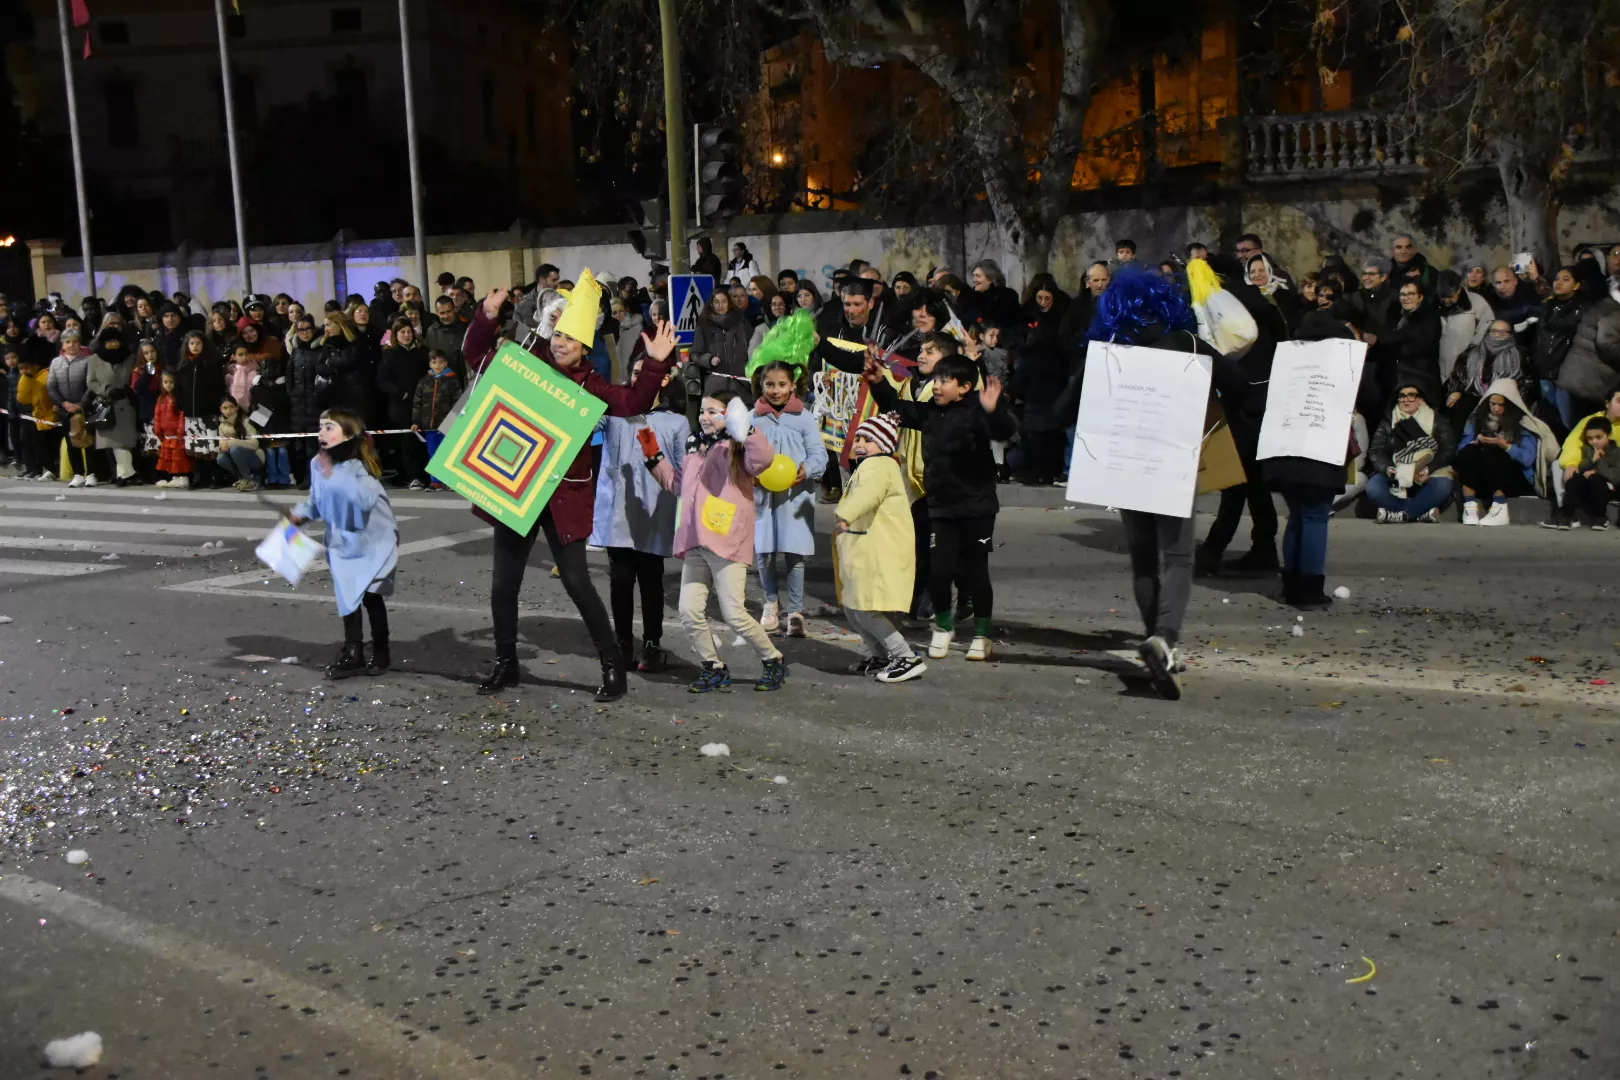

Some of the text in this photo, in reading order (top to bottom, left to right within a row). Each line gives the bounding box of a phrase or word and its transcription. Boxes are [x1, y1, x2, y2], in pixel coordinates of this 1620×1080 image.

[501, 354, 590, 417] NATURALEZA 6
[455, 482, 503, 516] santillana
